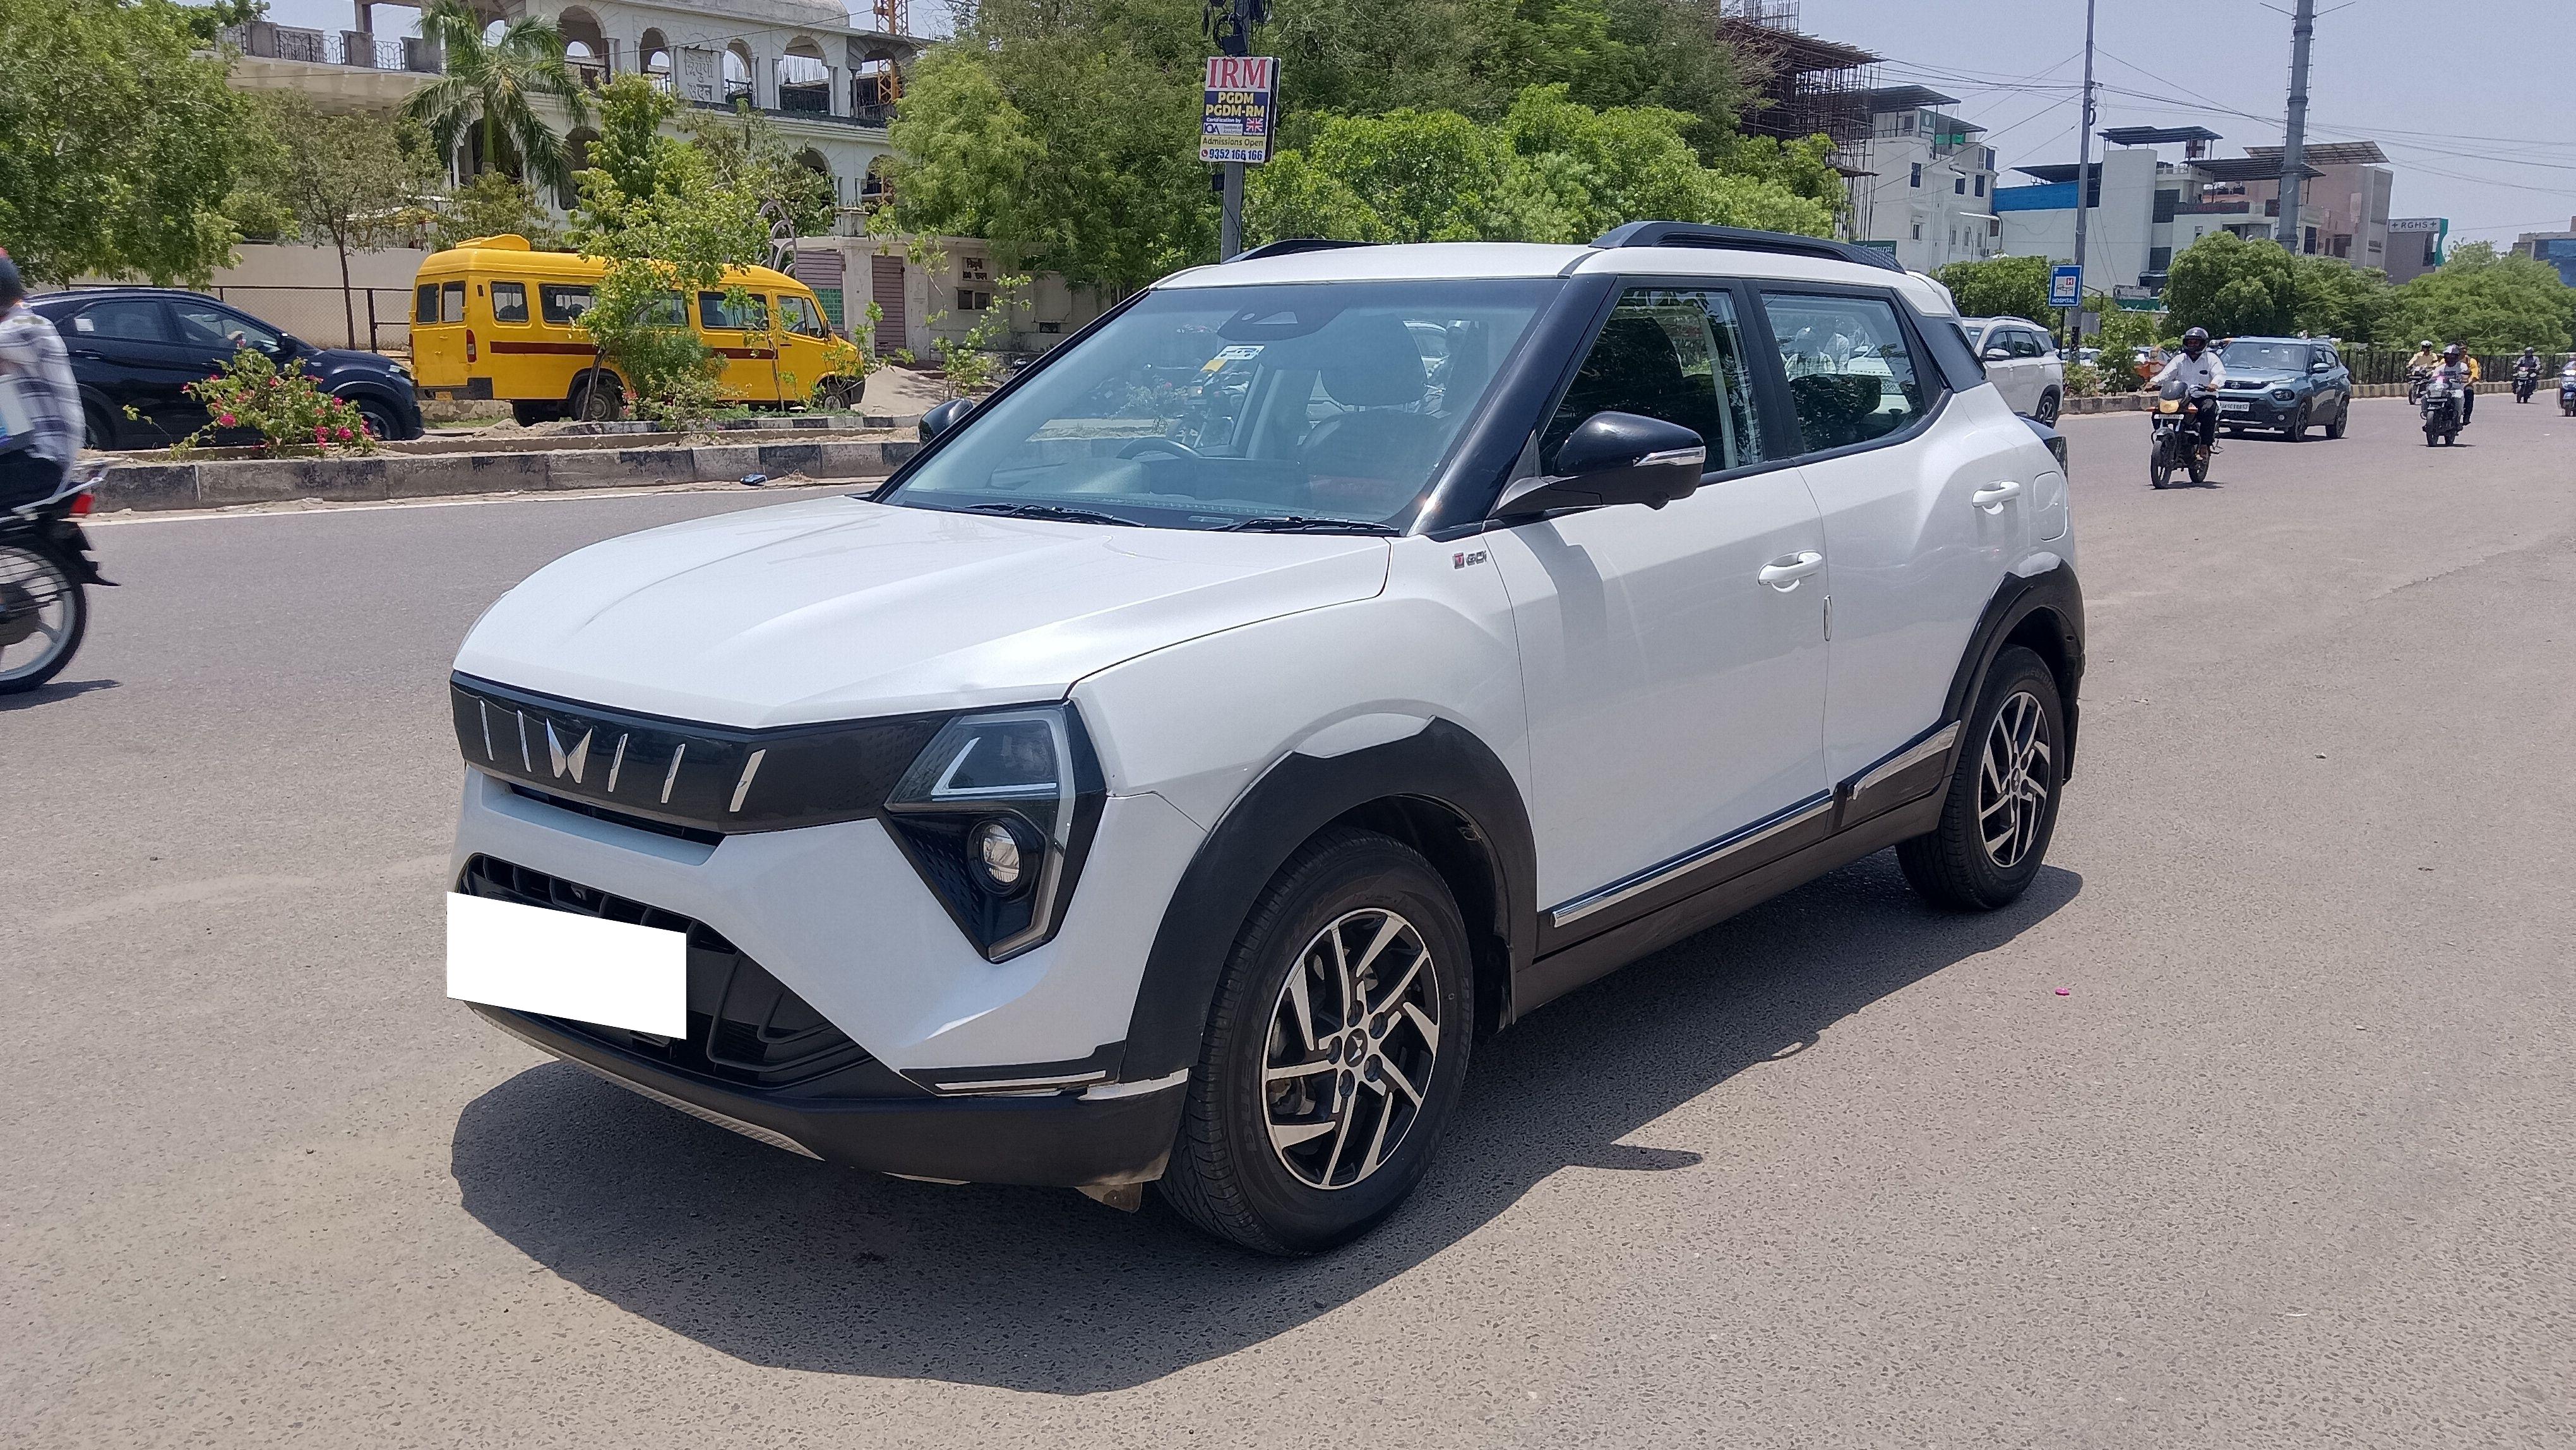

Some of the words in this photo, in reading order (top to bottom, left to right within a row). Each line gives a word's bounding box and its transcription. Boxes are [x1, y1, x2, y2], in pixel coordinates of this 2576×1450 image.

[1208, 59, 1267, 88] IRM
[1218, 92, 1255, 104] PGDM
[1205, 104, 1265, 117] PGDM-RM
[1202, 137, 1243, 146] Admissions
[1244, 138, 1263, 148] Open
[1209, 148, 1230, 159] 9352
[1231, 149, 1246, 160] 166
[1248, 150, 1263, 160] 166
